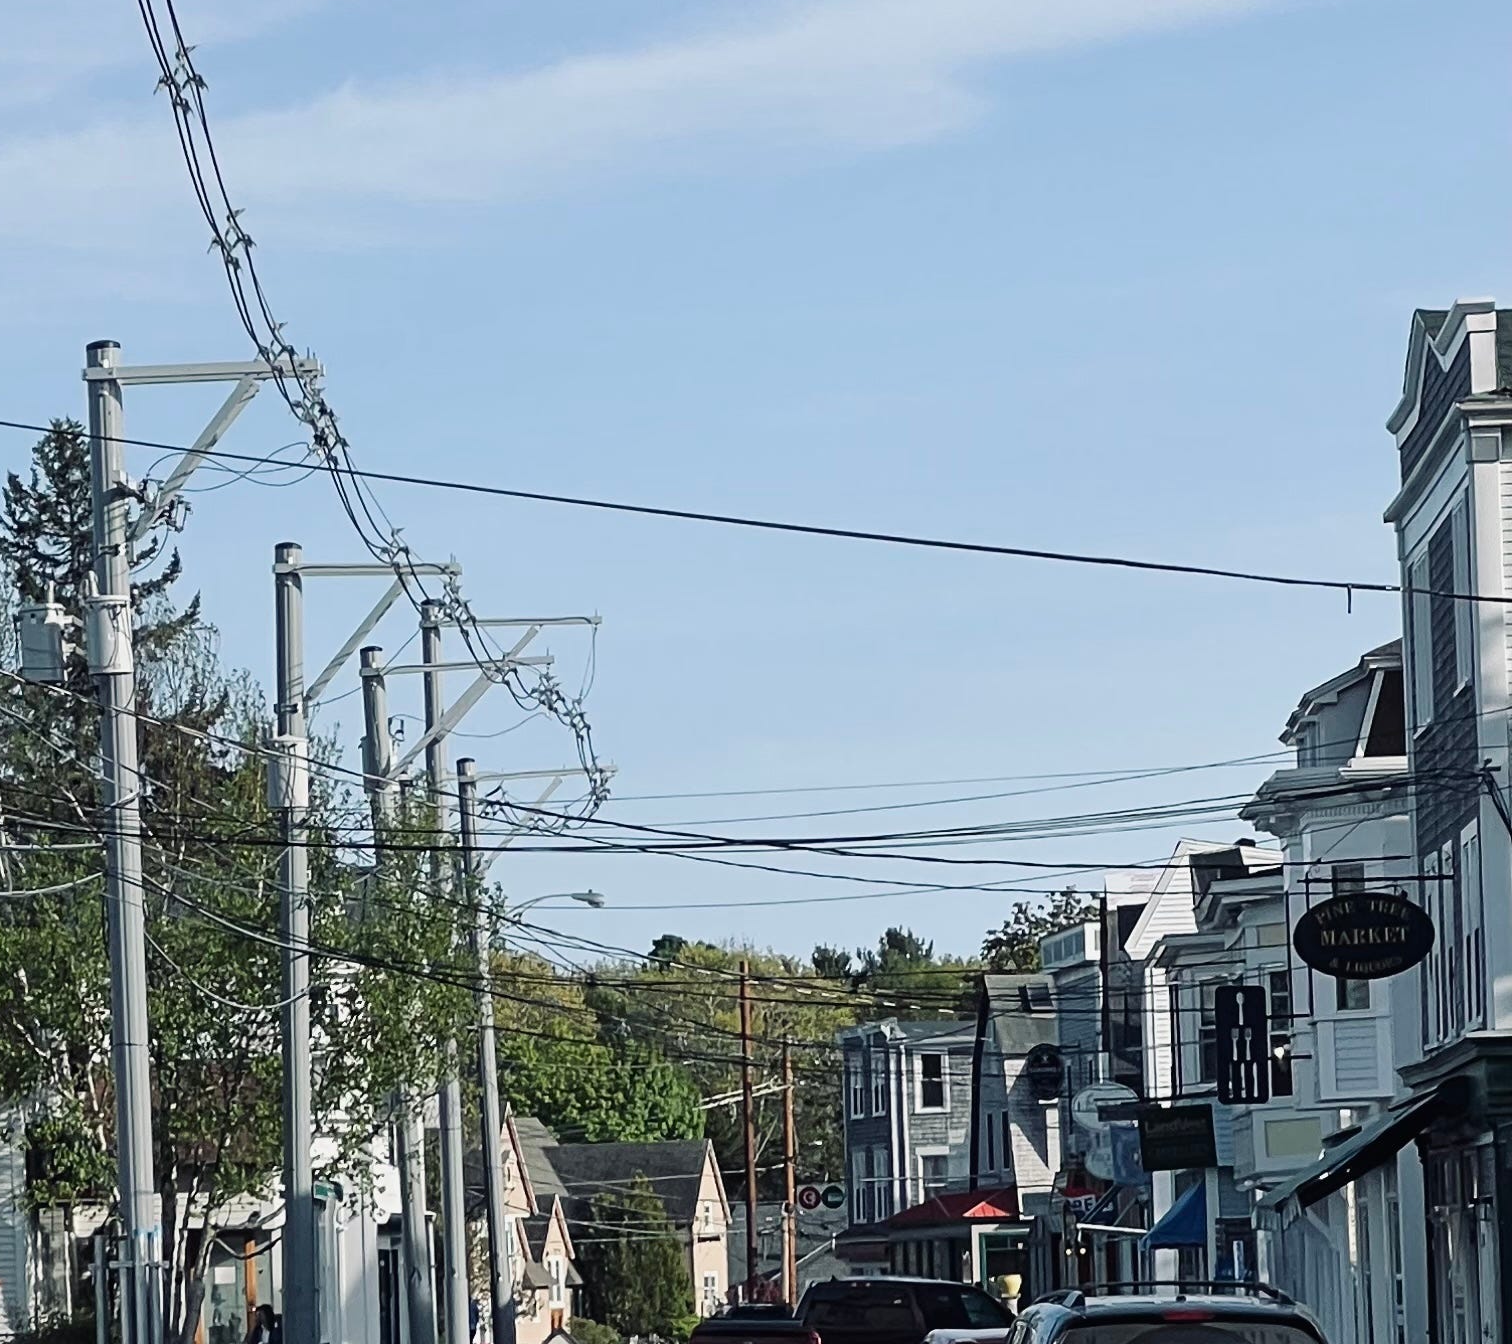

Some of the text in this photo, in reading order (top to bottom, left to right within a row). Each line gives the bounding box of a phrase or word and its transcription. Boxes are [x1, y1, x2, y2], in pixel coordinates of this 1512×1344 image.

[1315, 899, 1412, 925] PINE TREE
[1320, 925, 1410, 946] MARKET
